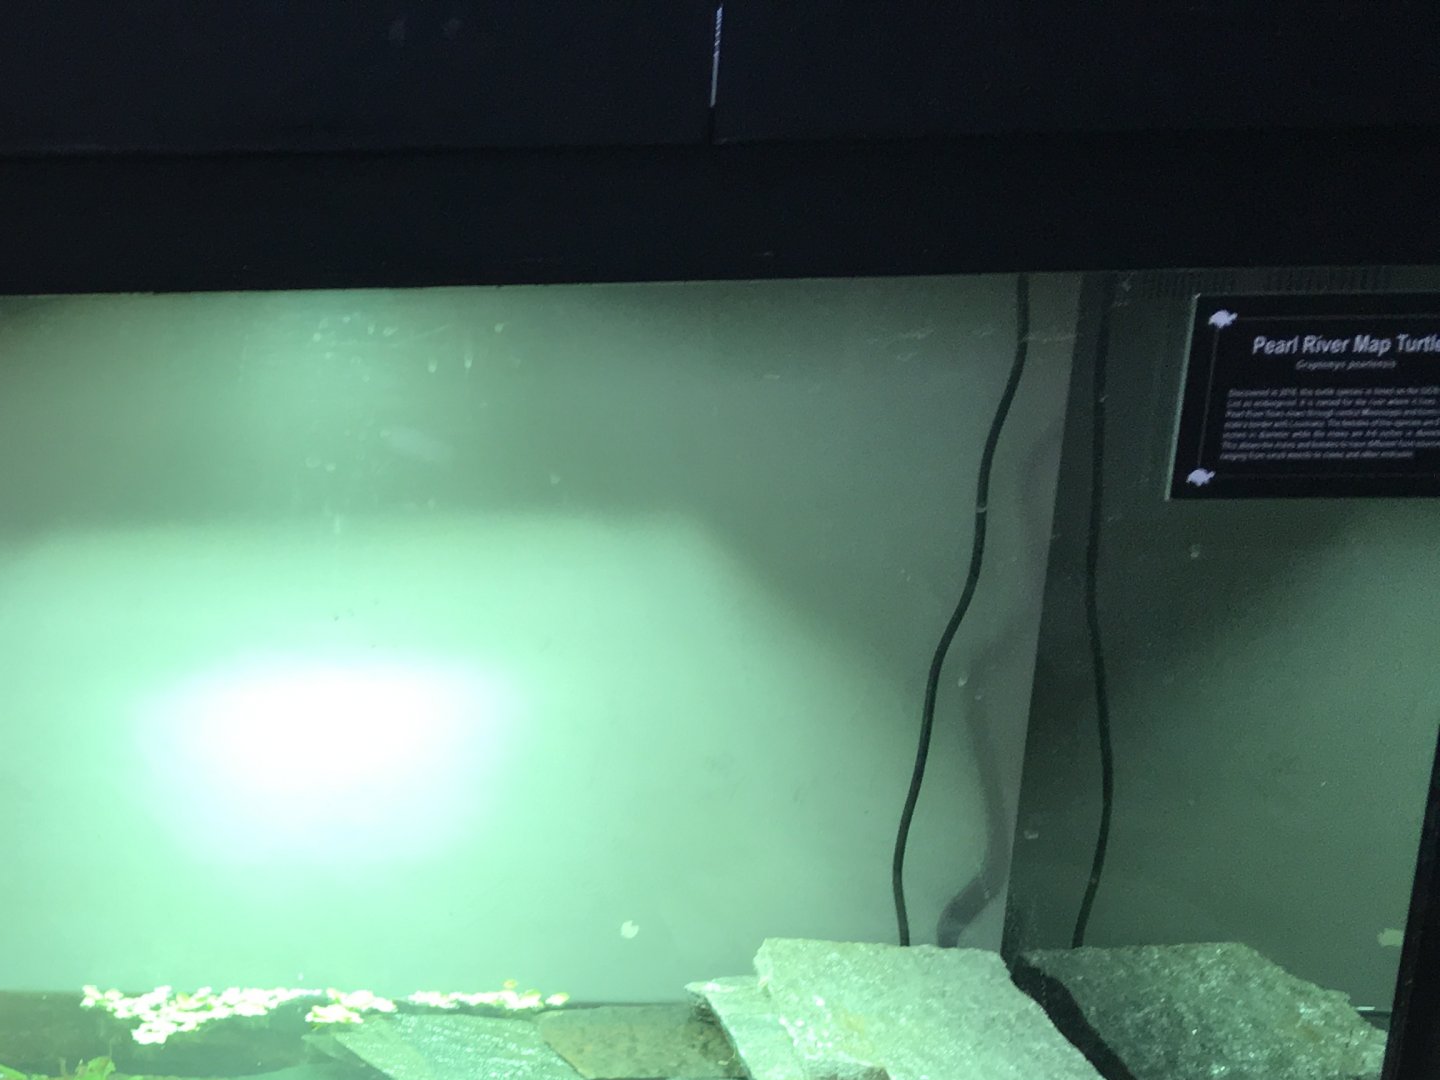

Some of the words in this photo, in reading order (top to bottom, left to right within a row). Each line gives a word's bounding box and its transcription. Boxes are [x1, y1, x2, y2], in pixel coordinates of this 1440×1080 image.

[1251, 334, 1299, 354] Pearl
[1303, 334, 1350, 354] River
[1352, 334, 1392, 357] Map
